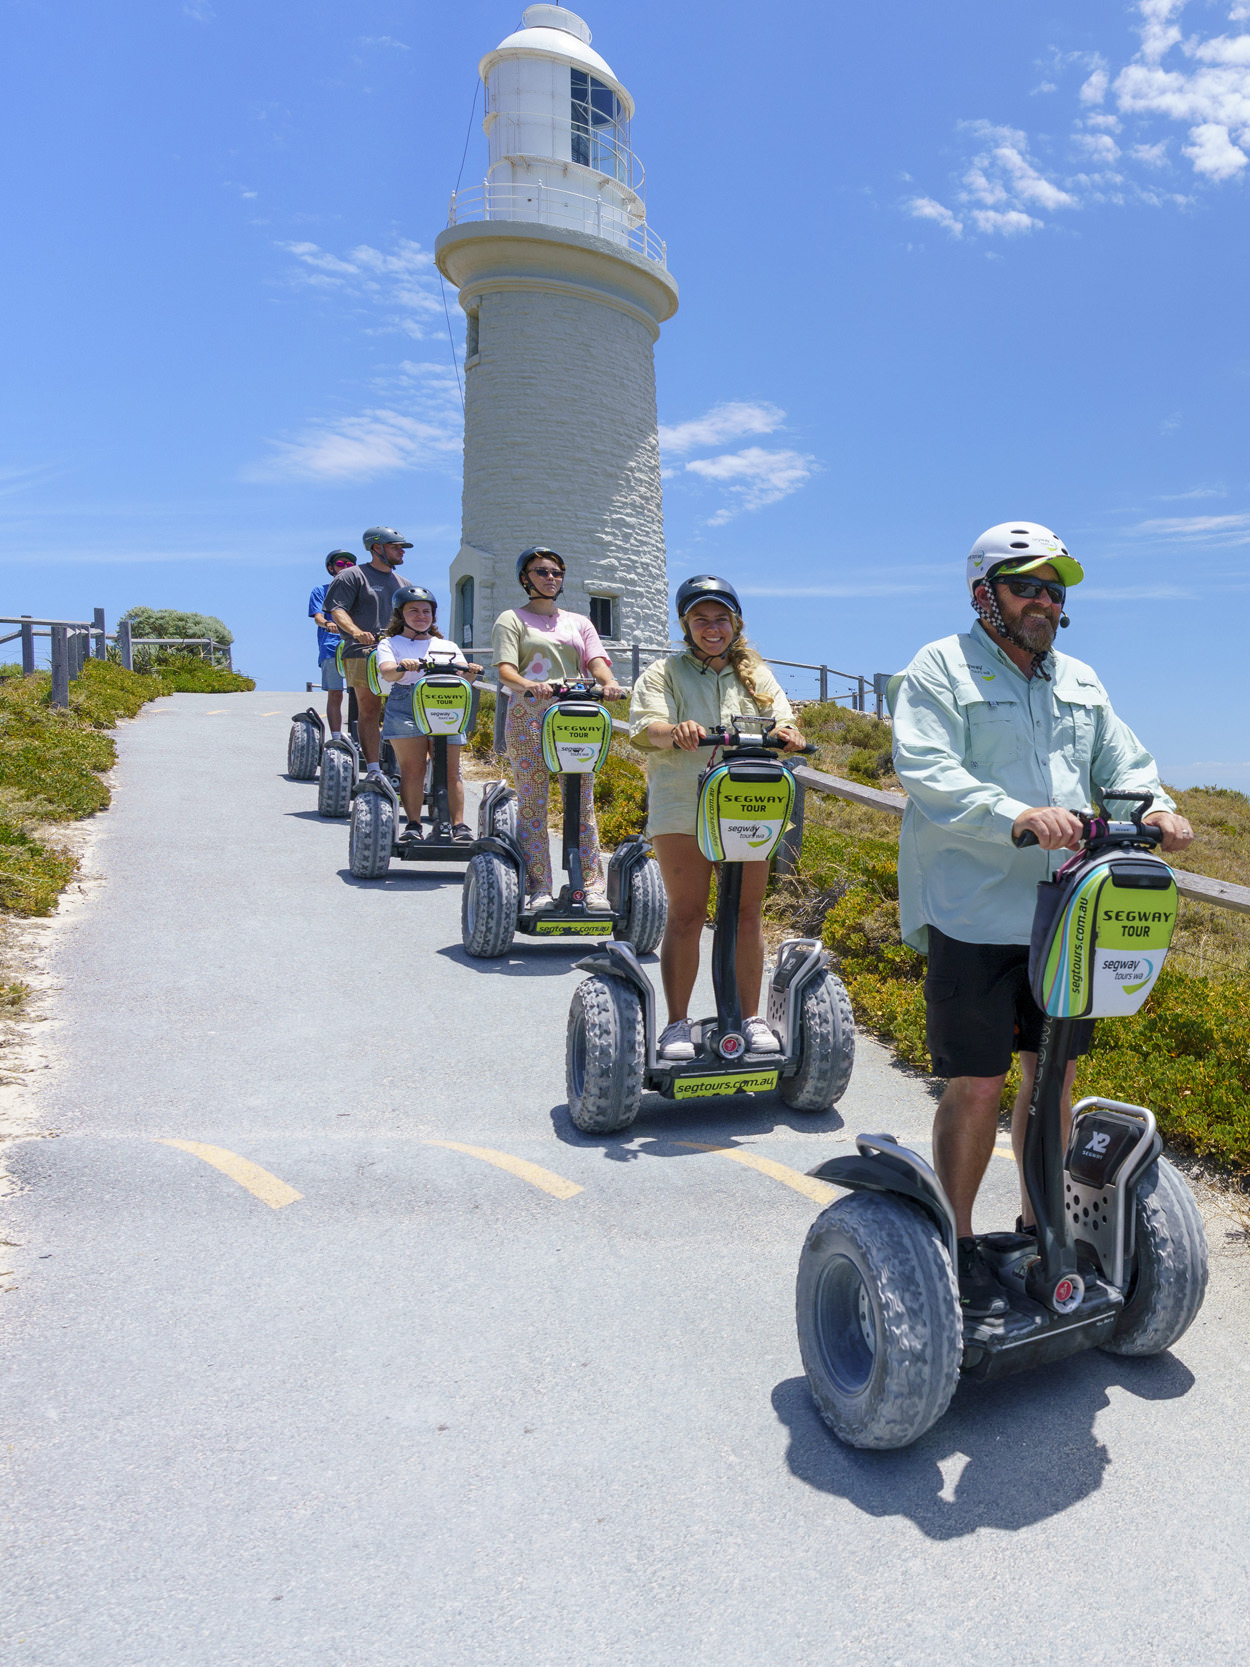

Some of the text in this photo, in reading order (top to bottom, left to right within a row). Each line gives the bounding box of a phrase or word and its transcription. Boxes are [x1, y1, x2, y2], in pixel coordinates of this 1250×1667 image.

[723, 795, 785, 803] SEGWAY
[740, 804, 767, 813] TOUR
[727, 824, 761, 834] segway
[1102, 910, 1174, 923] SEGWAY
[1121, 925, 1151, 938] TOUR
[1071, 897, 1089, 995] segtours.com.au
[1102, 960, 1141, 972] segway
[1114, 972, 1133, 981] tours
[676, 1077, 775, 1094] segtours.com.au
[1085, 1131, 1111, 1153] X2
